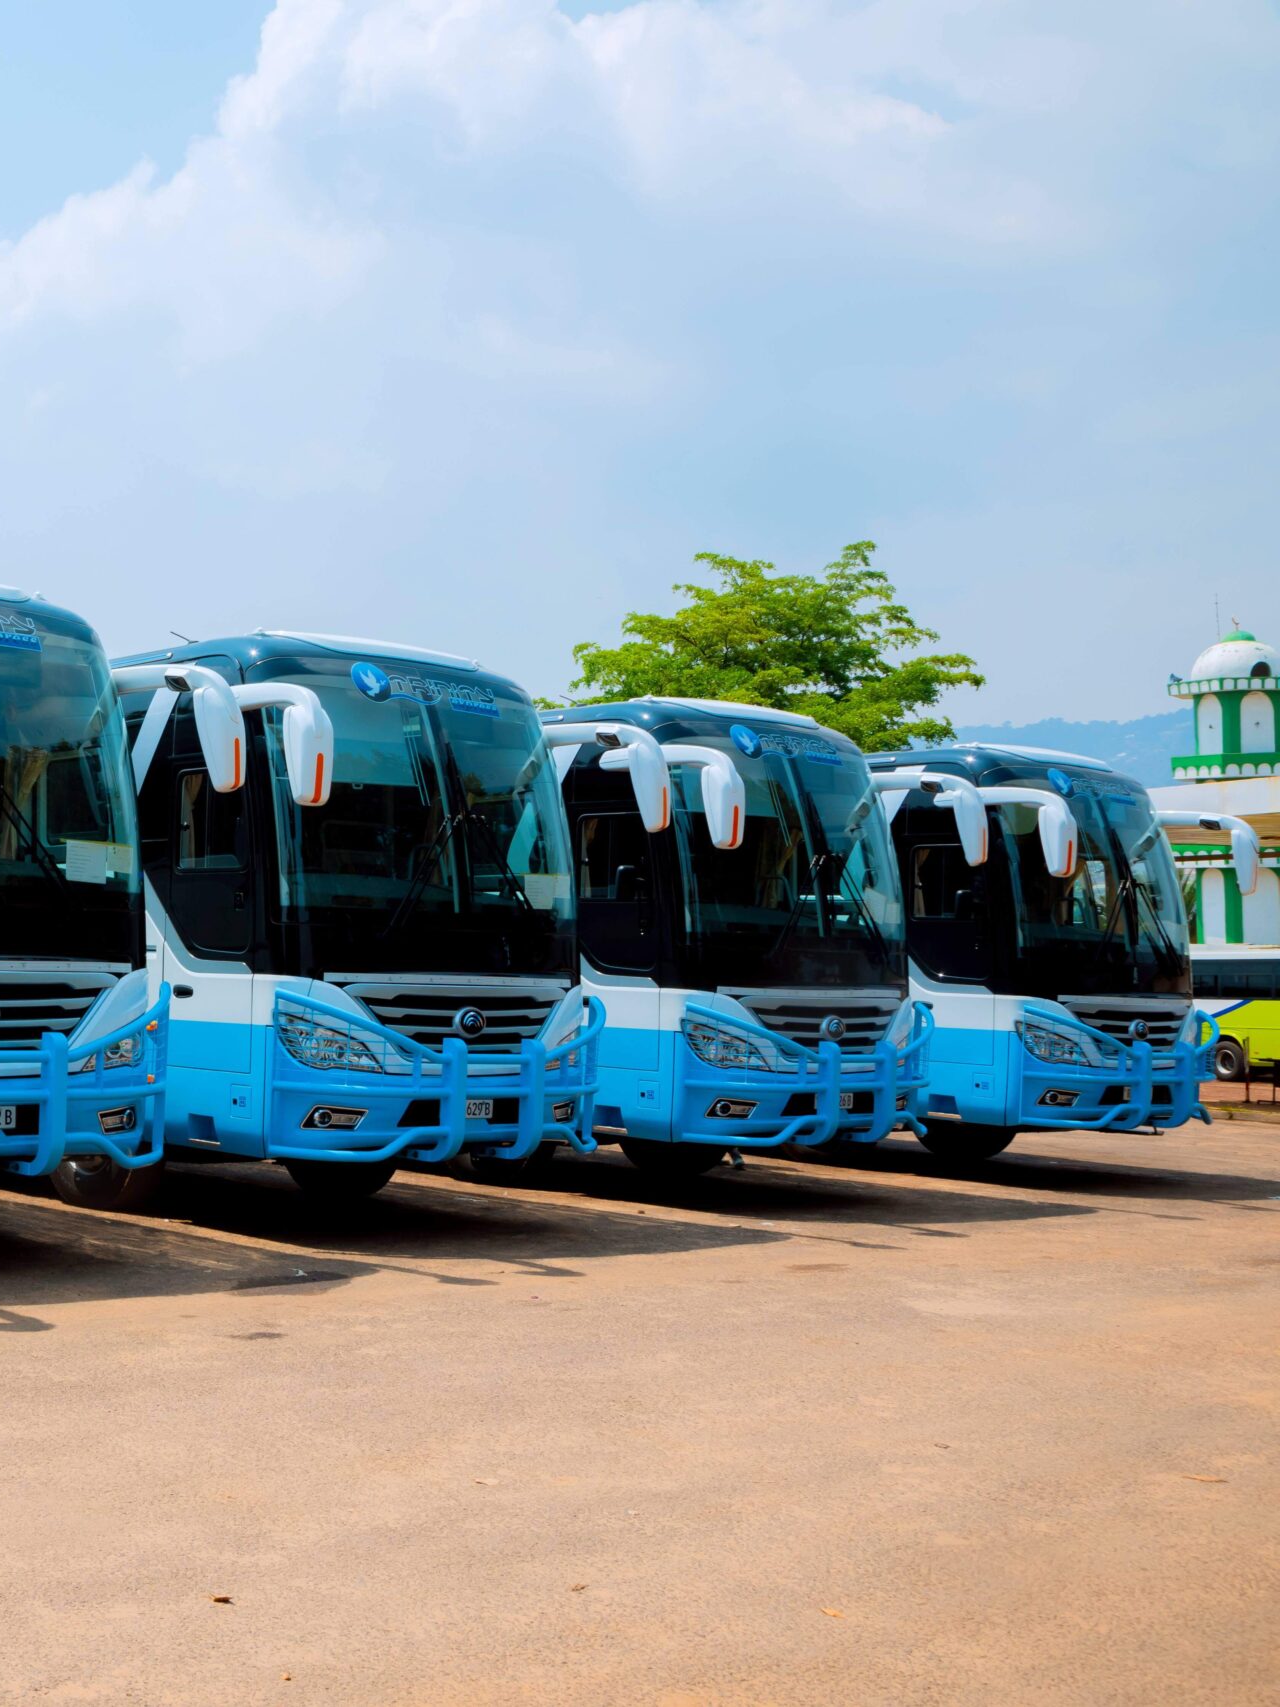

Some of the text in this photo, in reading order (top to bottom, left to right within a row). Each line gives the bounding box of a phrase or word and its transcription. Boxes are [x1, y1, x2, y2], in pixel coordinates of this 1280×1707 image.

[388, 675, 496, 704] TRINITY
[466, 1101, 491, 1116] 629 B
[4, 1109, 13, 1125] B
